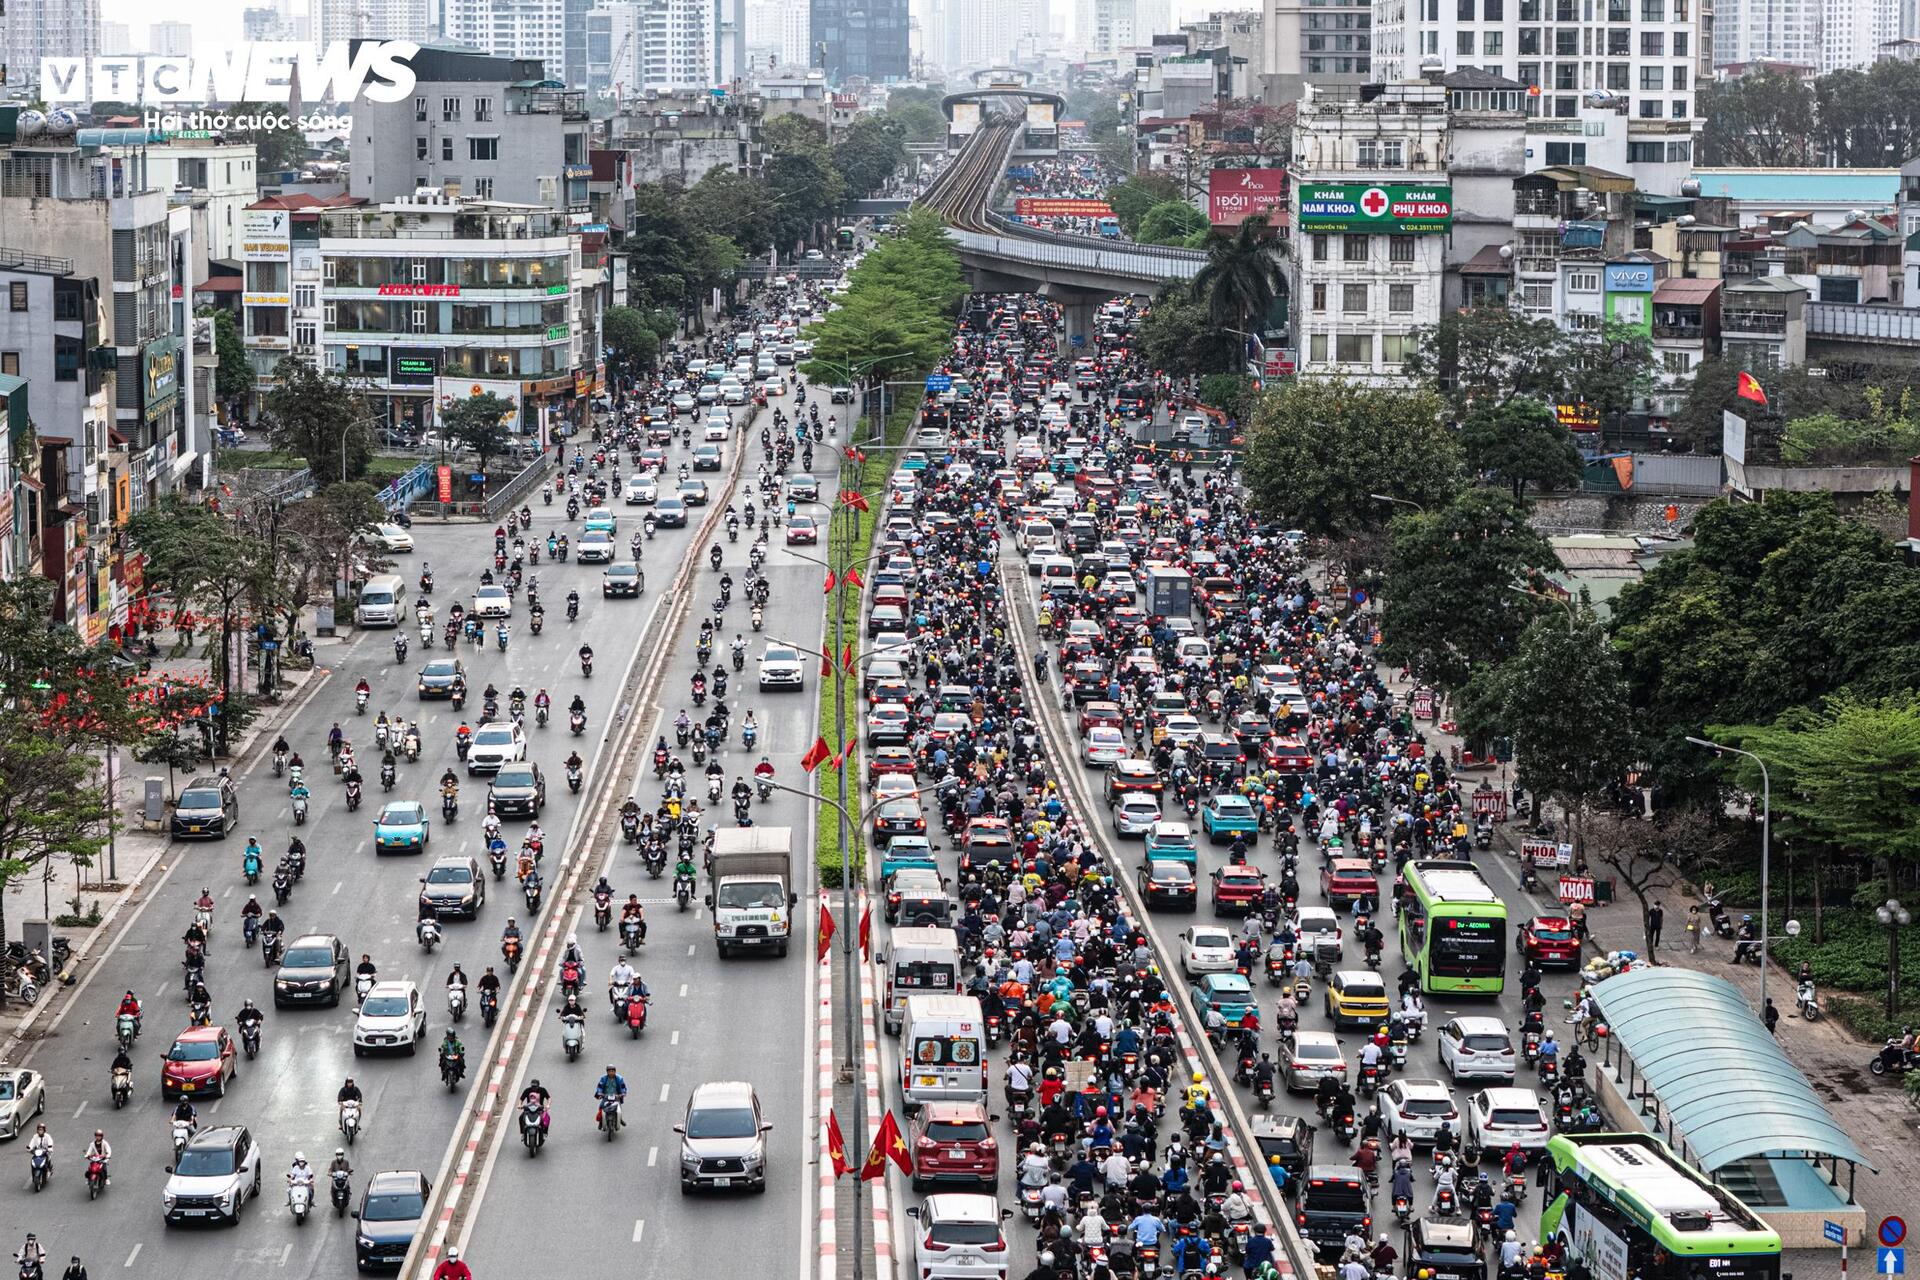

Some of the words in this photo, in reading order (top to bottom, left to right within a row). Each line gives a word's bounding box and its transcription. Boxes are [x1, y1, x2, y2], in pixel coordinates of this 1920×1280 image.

[1314, 191, 1344, 200] KHÁM
[1406, 191, 1436, 200] KHÁM
[1302, 204, 1325, 213] NAM
[1327, 204, 1356, 213] KHOA
[1393, 204, 1415, 216] PHỤ
[1418, 204, 1448, 214] KHOA
[377, 283, 413, 296] ARIES
[416, 284, 460, 296] COFFEE
